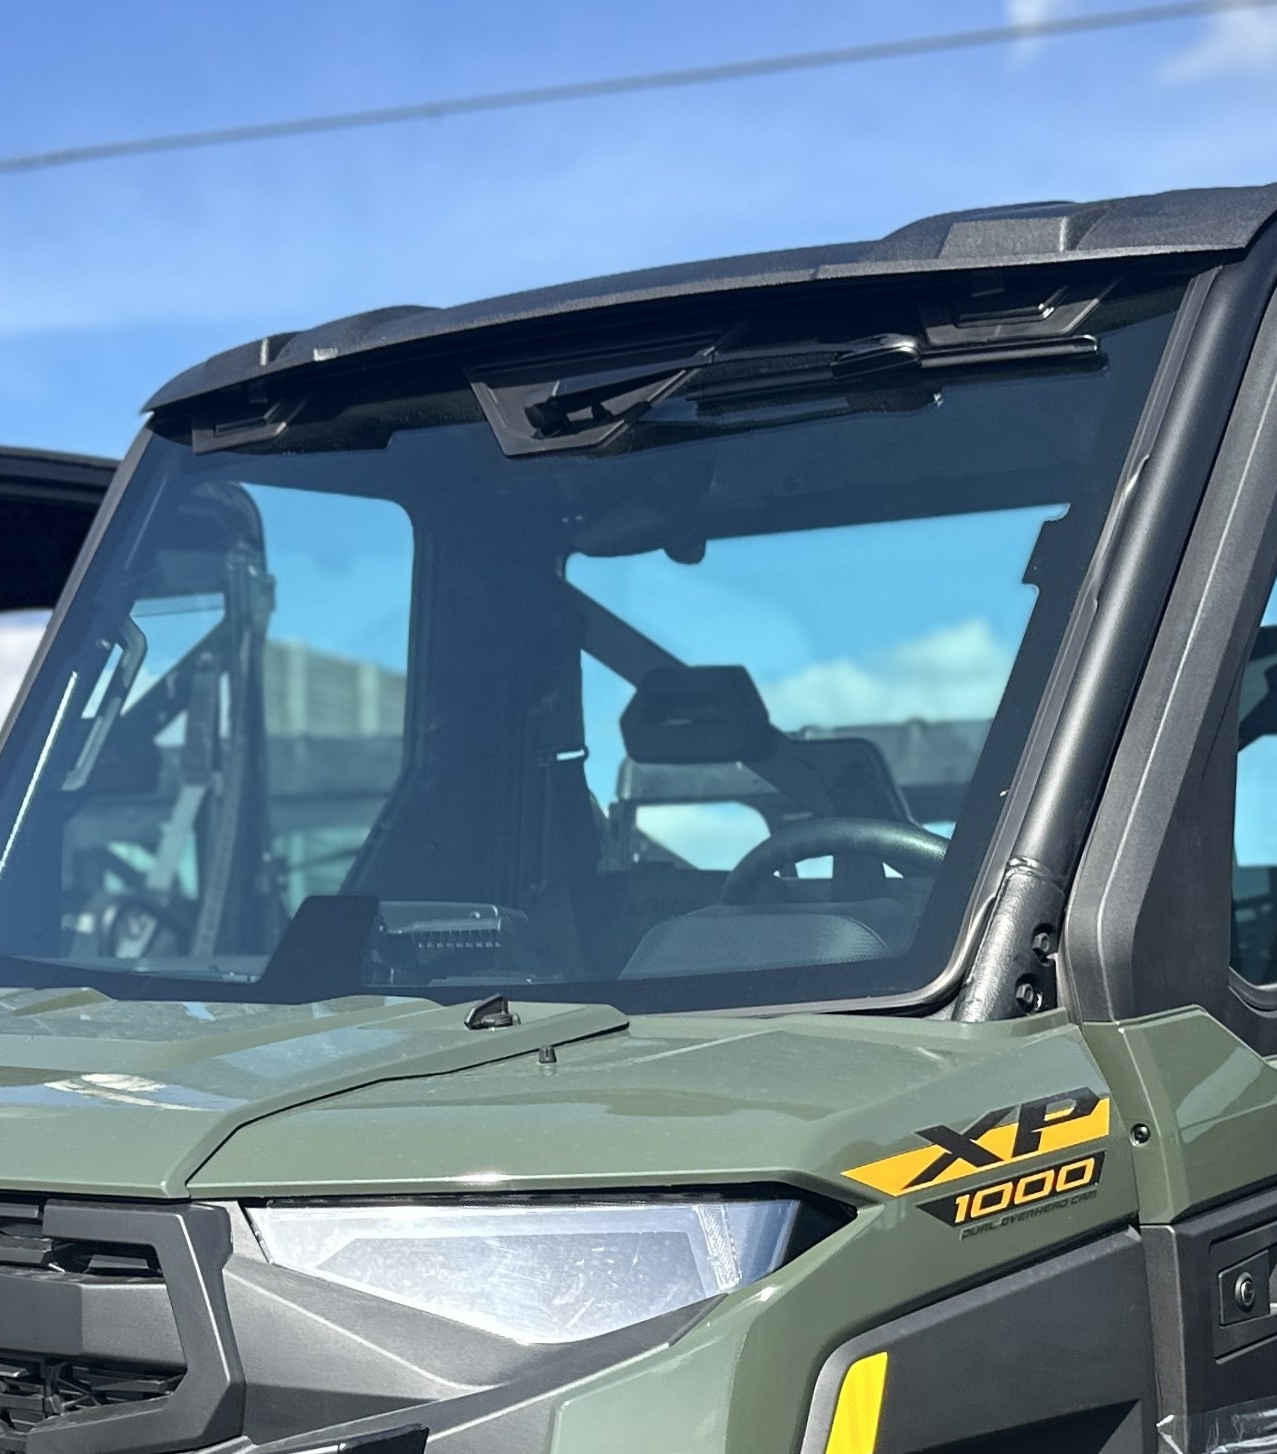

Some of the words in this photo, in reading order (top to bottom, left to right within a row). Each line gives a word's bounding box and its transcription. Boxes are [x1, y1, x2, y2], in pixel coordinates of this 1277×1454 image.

[900, 1086, 1101, 1191] XP
[955, 1157, 1095, 1224] 1000
[960, 1222, 997, 1240] DUAL
[1001, 1199, 1069, 1226] OVERHEAD
[1070, 1189, 1098, 1205] CAM
